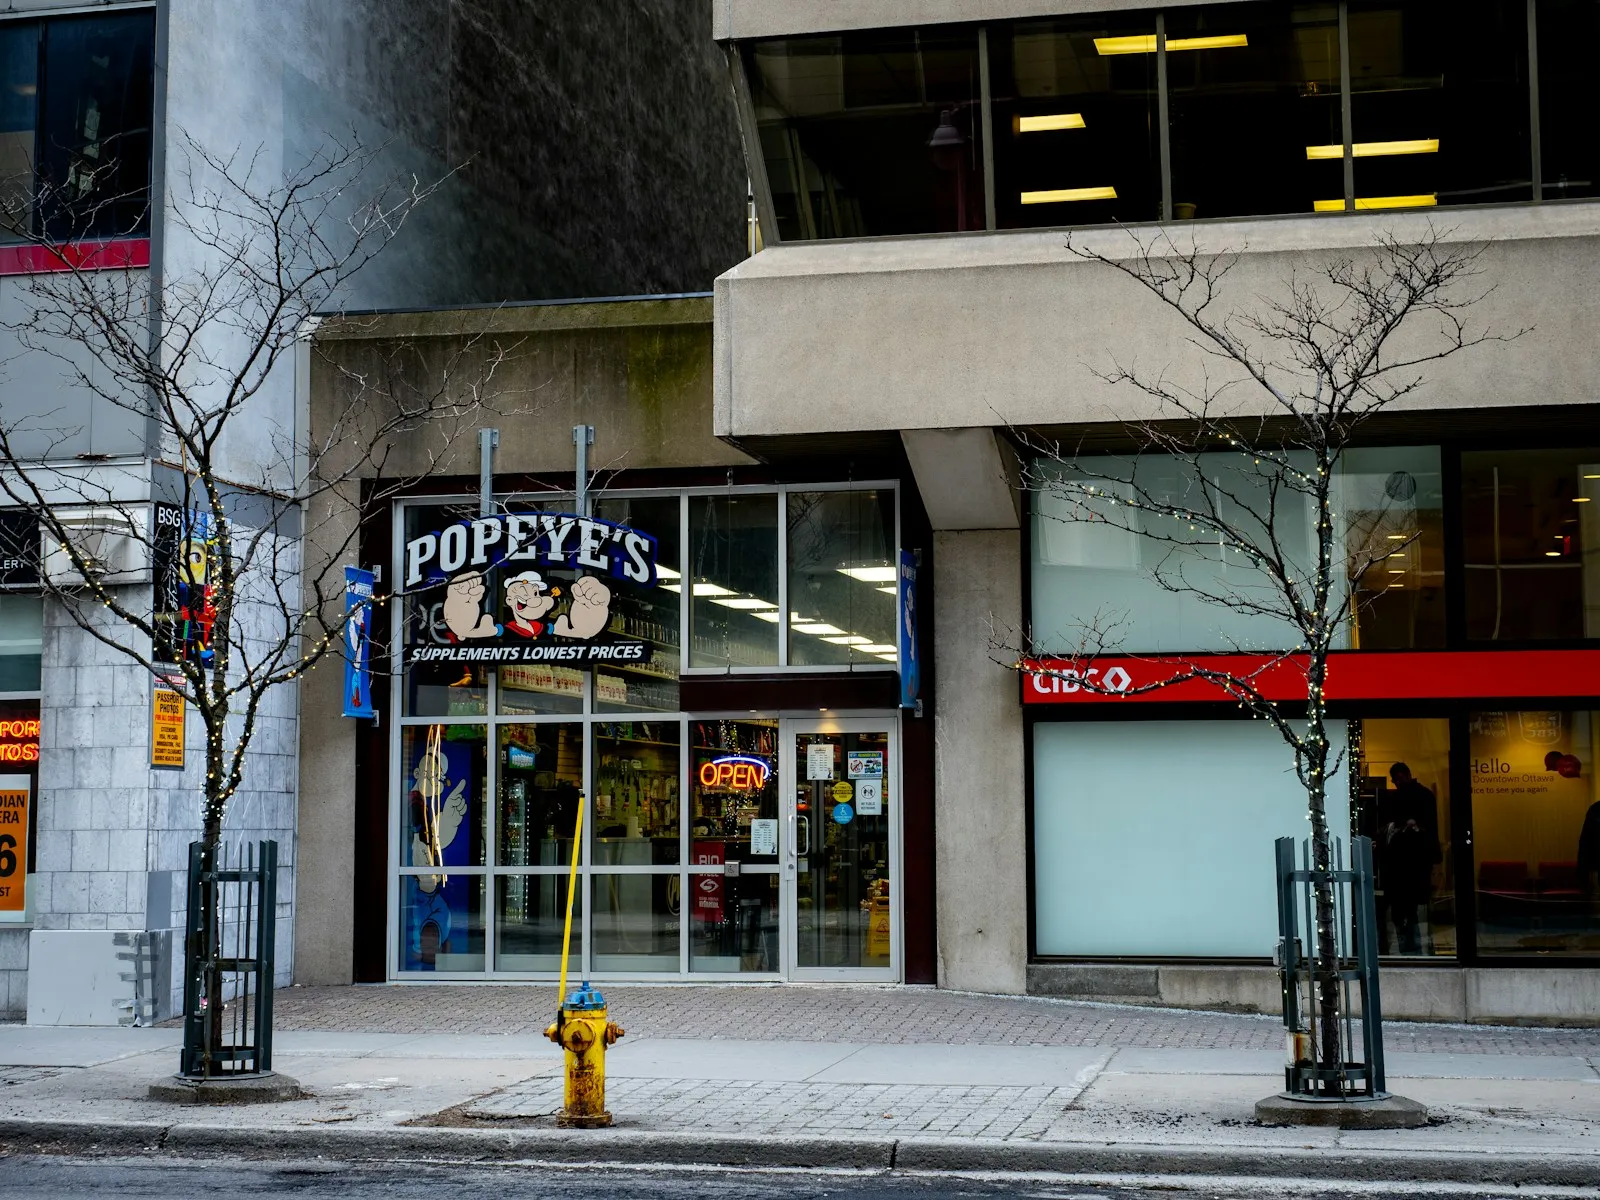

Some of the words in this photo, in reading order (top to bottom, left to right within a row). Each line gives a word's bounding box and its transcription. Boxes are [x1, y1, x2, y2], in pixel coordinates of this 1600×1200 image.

[158, 506, 181, 527] BSG
[405, 515, 650, 588] POPEYE'S
[411, 647, 520, 661] SUPPLEMENTS
[522, 646, 586, 660] LOWEST
[587, 645, 643, 659] PRICES
[160, 703, 179, 714] PHOTOS
[0, 720, 40, 738] POR
[1470, 758, 1511, 774] Hello
[700, 762, 764, 788] OPEN
[1472, 775, 1520, 784] Downtown
[1521, 773, 1554, 783] Ottawa
[1470, 786, 1484, 794] ice
[1486, 786, 1494, 794] to
[1511, 787, 1525, 796] you
[1526, 786, 1548, 795] again
[0, 834, 17, 877] 6
